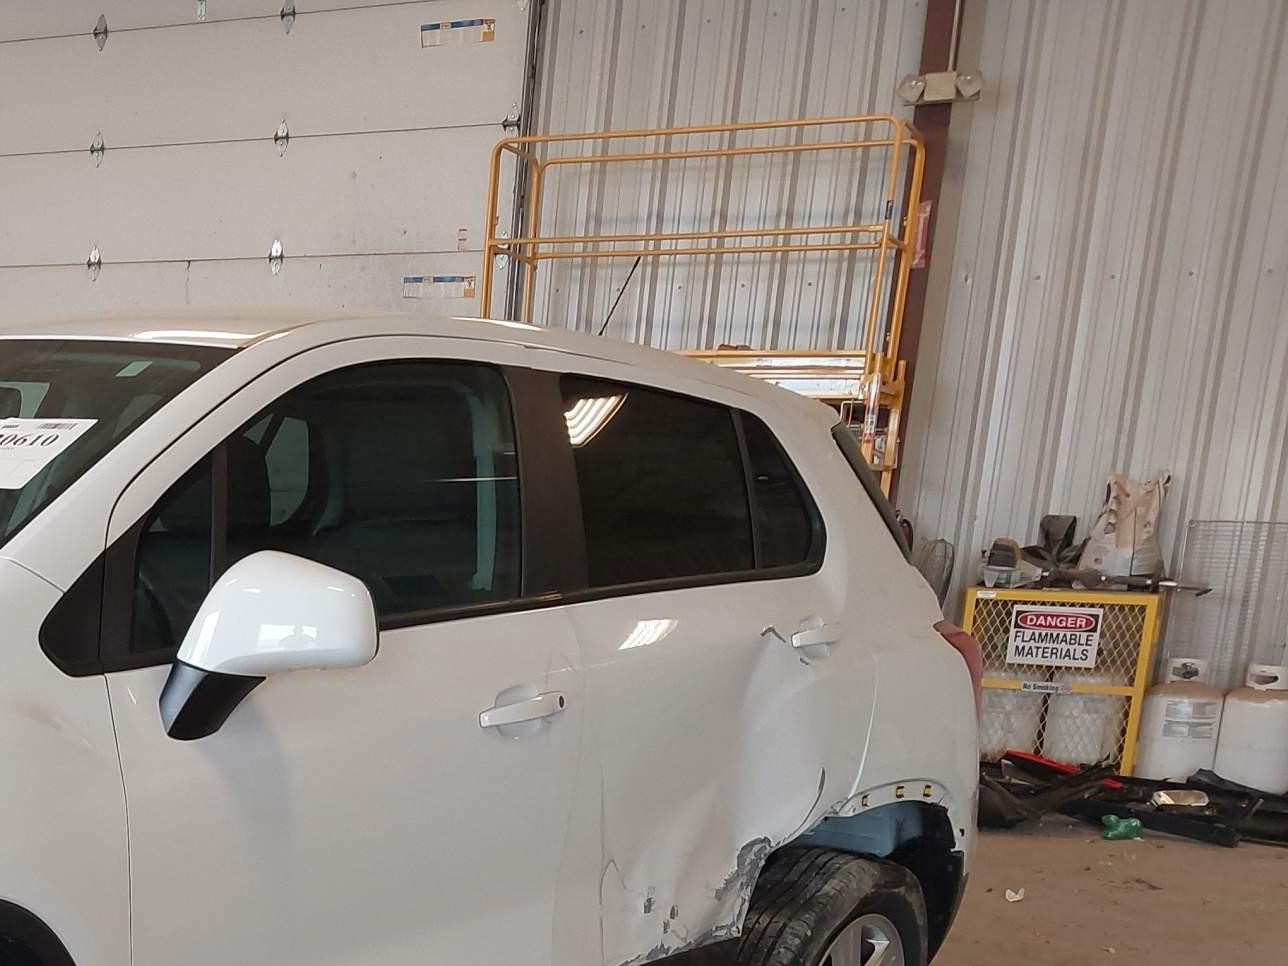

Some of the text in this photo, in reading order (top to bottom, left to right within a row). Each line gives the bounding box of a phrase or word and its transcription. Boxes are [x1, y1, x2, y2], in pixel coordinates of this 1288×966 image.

[1026, 615, 1087, 628] DANGER
[1014, 630, 1093, 647] FLAMMABLE
[1014, 645, 1089, 661] MATERIALS
[1023, 682, 1059, 693] No Smoking
